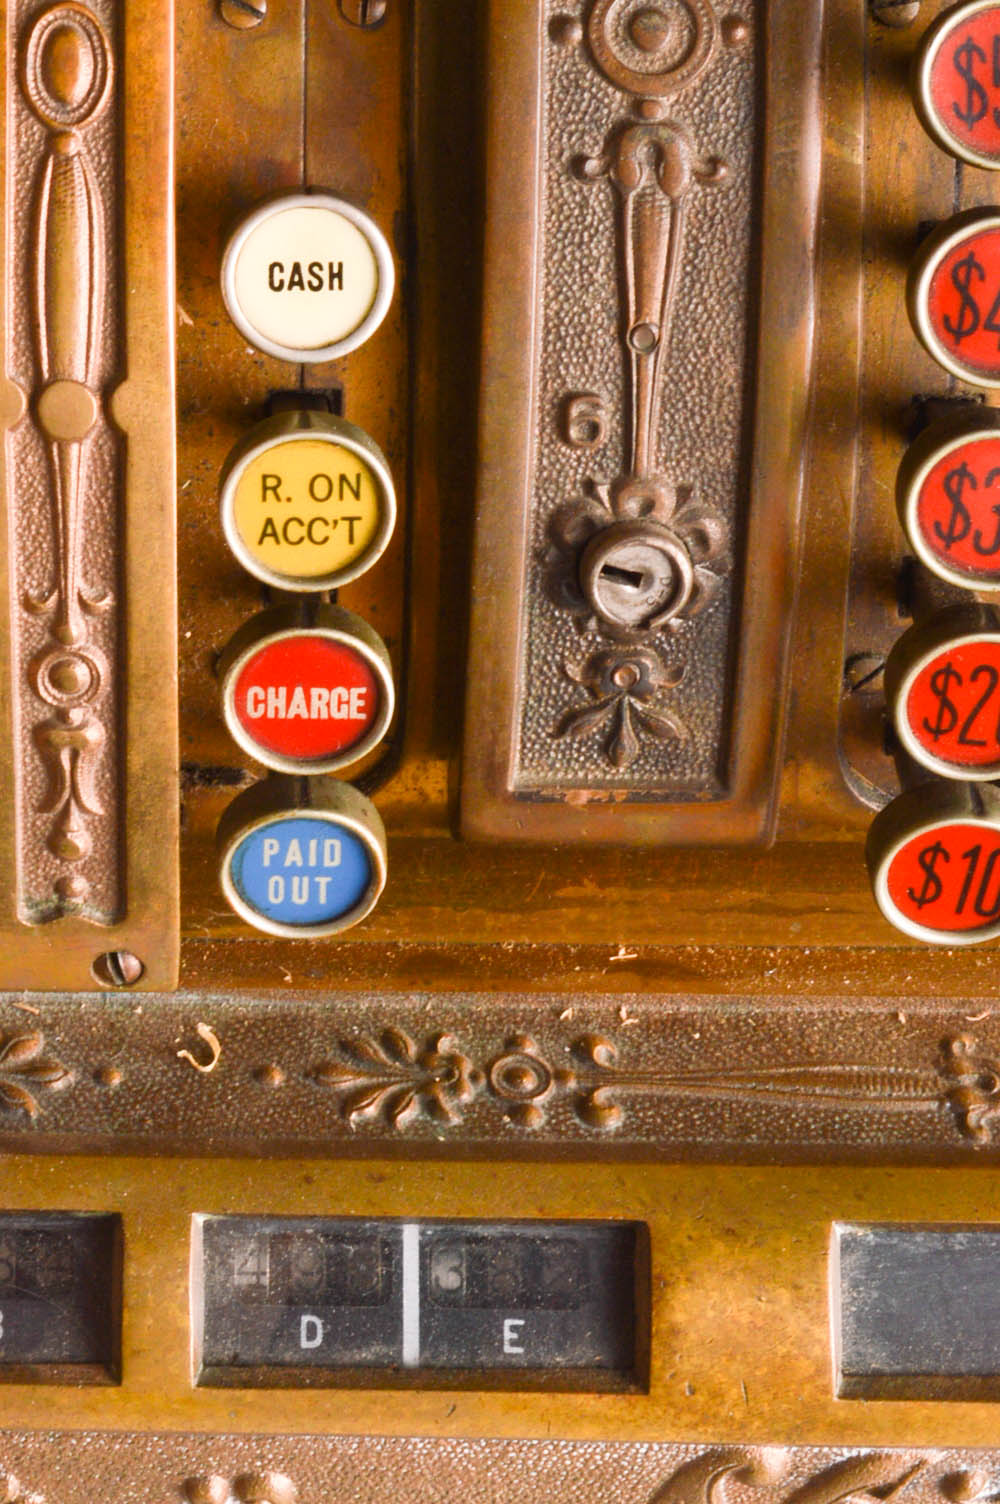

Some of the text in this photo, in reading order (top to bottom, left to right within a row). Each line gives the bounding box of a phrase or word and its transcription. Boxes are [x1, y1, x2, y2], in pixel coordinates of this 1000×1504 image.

[267, 261, 344, 292] CASH
[261, 471, 362, 503] R. ON
[258, 516, 363, 546] ACC'T
[246, 685, 367, 720] CHARGE
[922, 661, 1000, 747] $2
[263, 838, 343, 867] PAID
[268, 875, 332, 904] OUT
[299, 1314, 324, 1349] D
[502, 1319, 526, 1354] E
